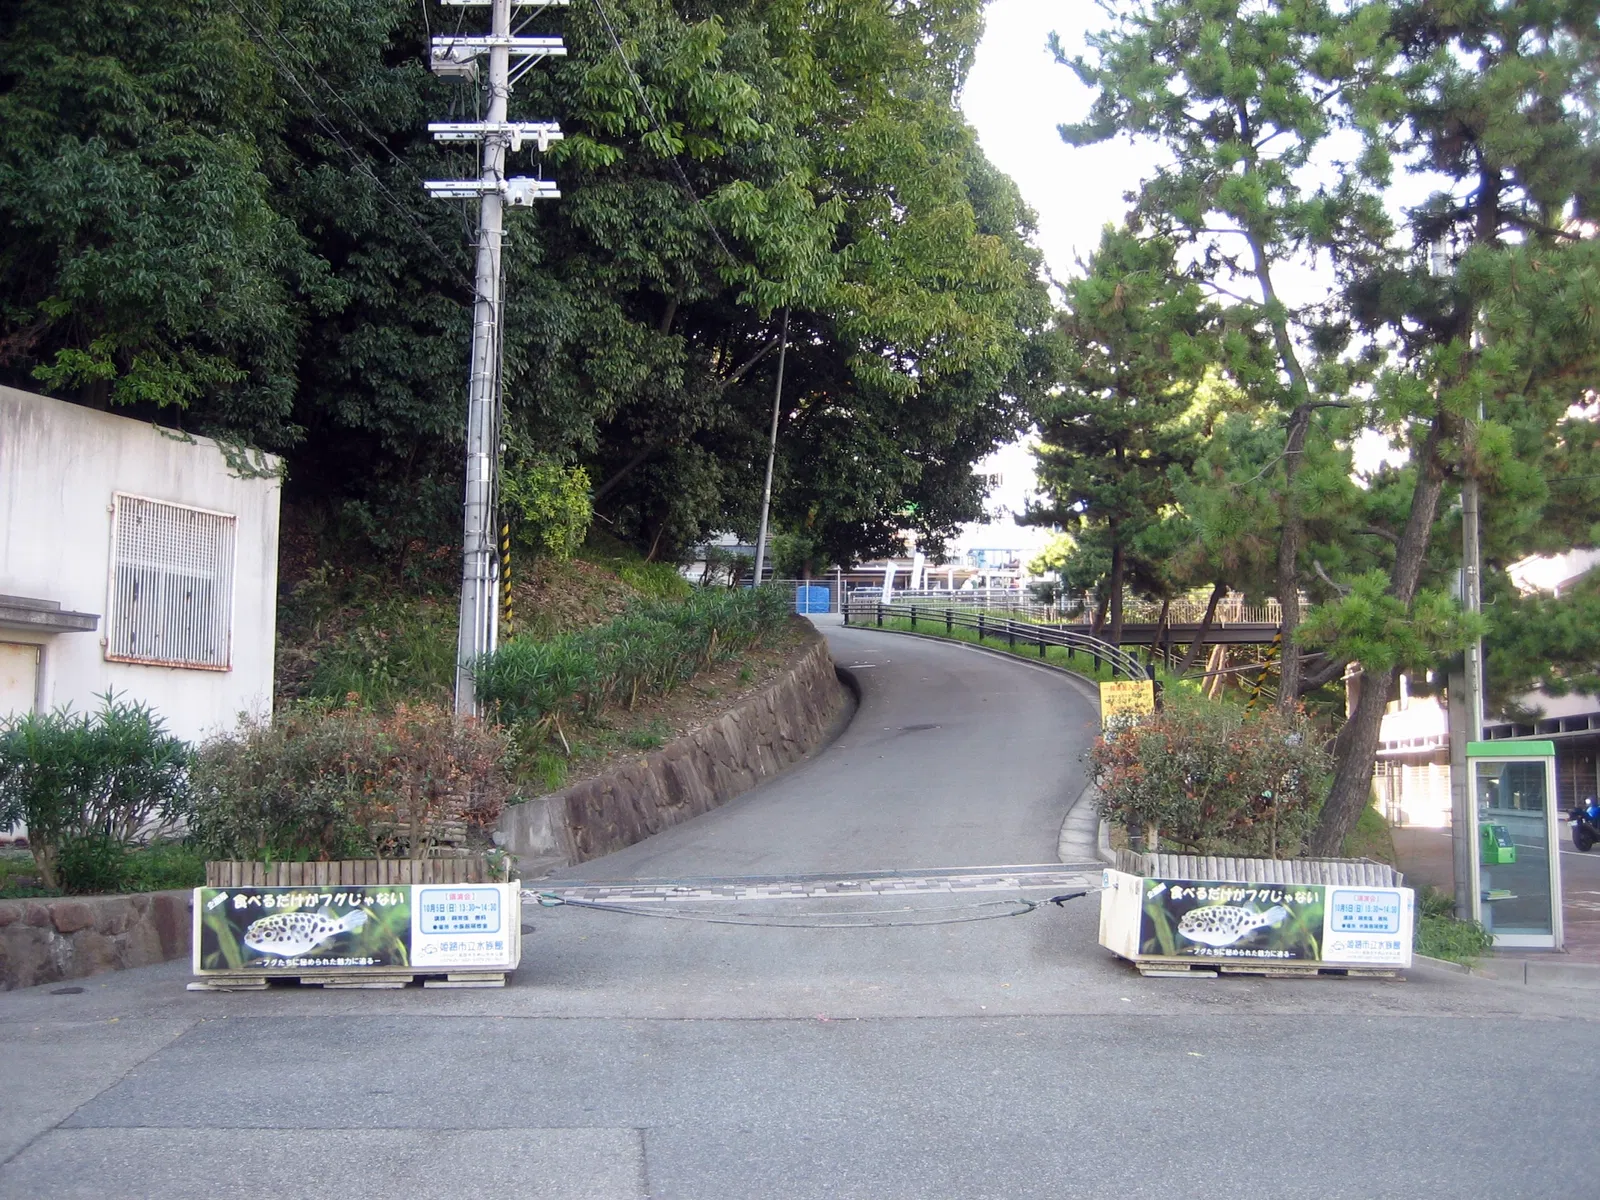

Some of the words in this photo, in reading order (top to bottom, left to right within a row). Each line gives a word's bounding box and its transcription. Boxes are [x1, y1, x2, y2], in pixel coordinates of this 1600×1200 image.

[233, 892, 405, 909] 食べるだけがフグじゃない
[1170, 885, 1319, 904] 食べるだけがフグじゃない
